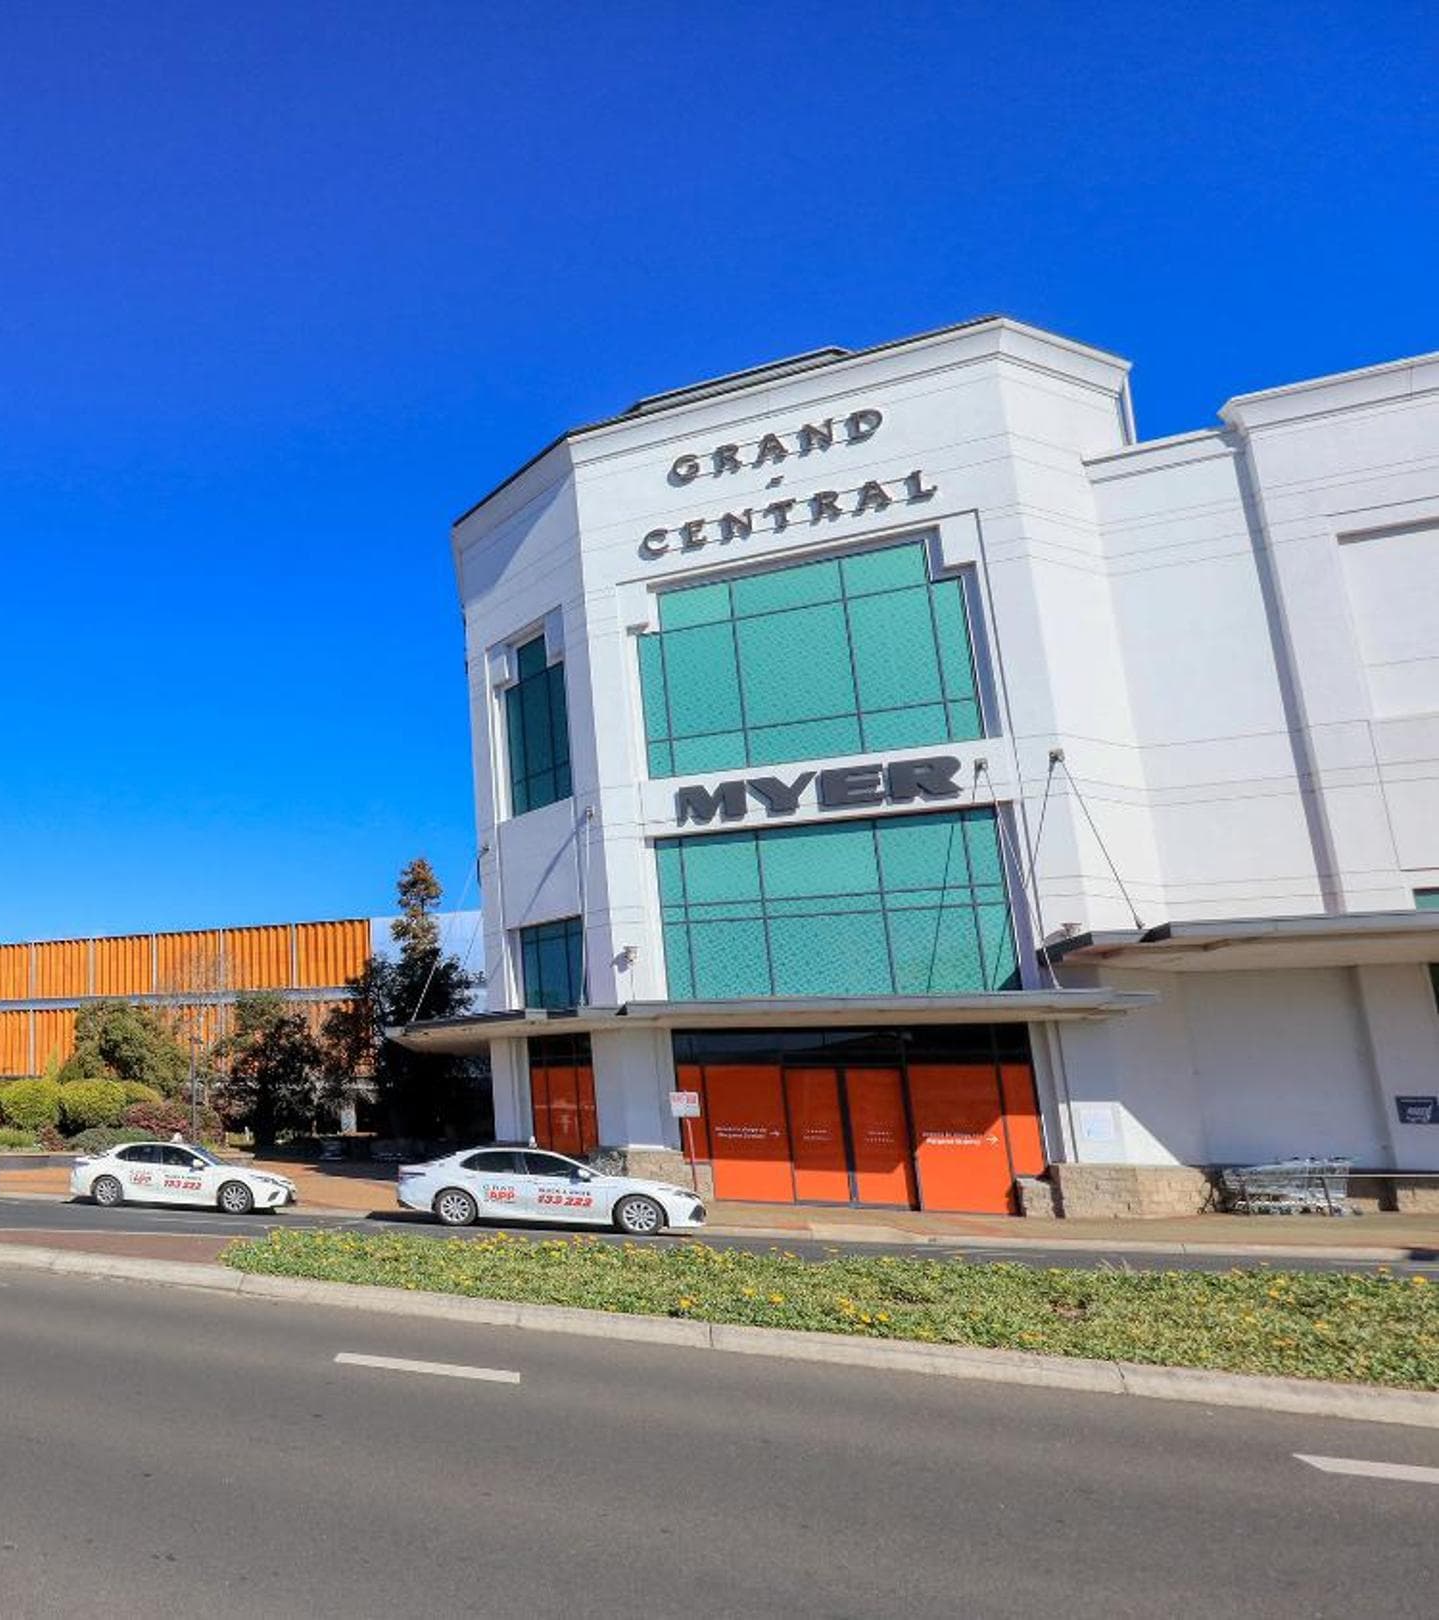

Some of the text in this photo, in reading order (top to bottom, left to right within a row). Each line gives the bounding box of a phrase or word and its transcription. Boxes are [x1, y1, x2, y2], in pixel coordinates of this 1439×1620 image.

[667, 408, 883, 487] GRAND
[638, 470, 938, 561] CENTRAL
[675, 755, 963, 827] MYER
